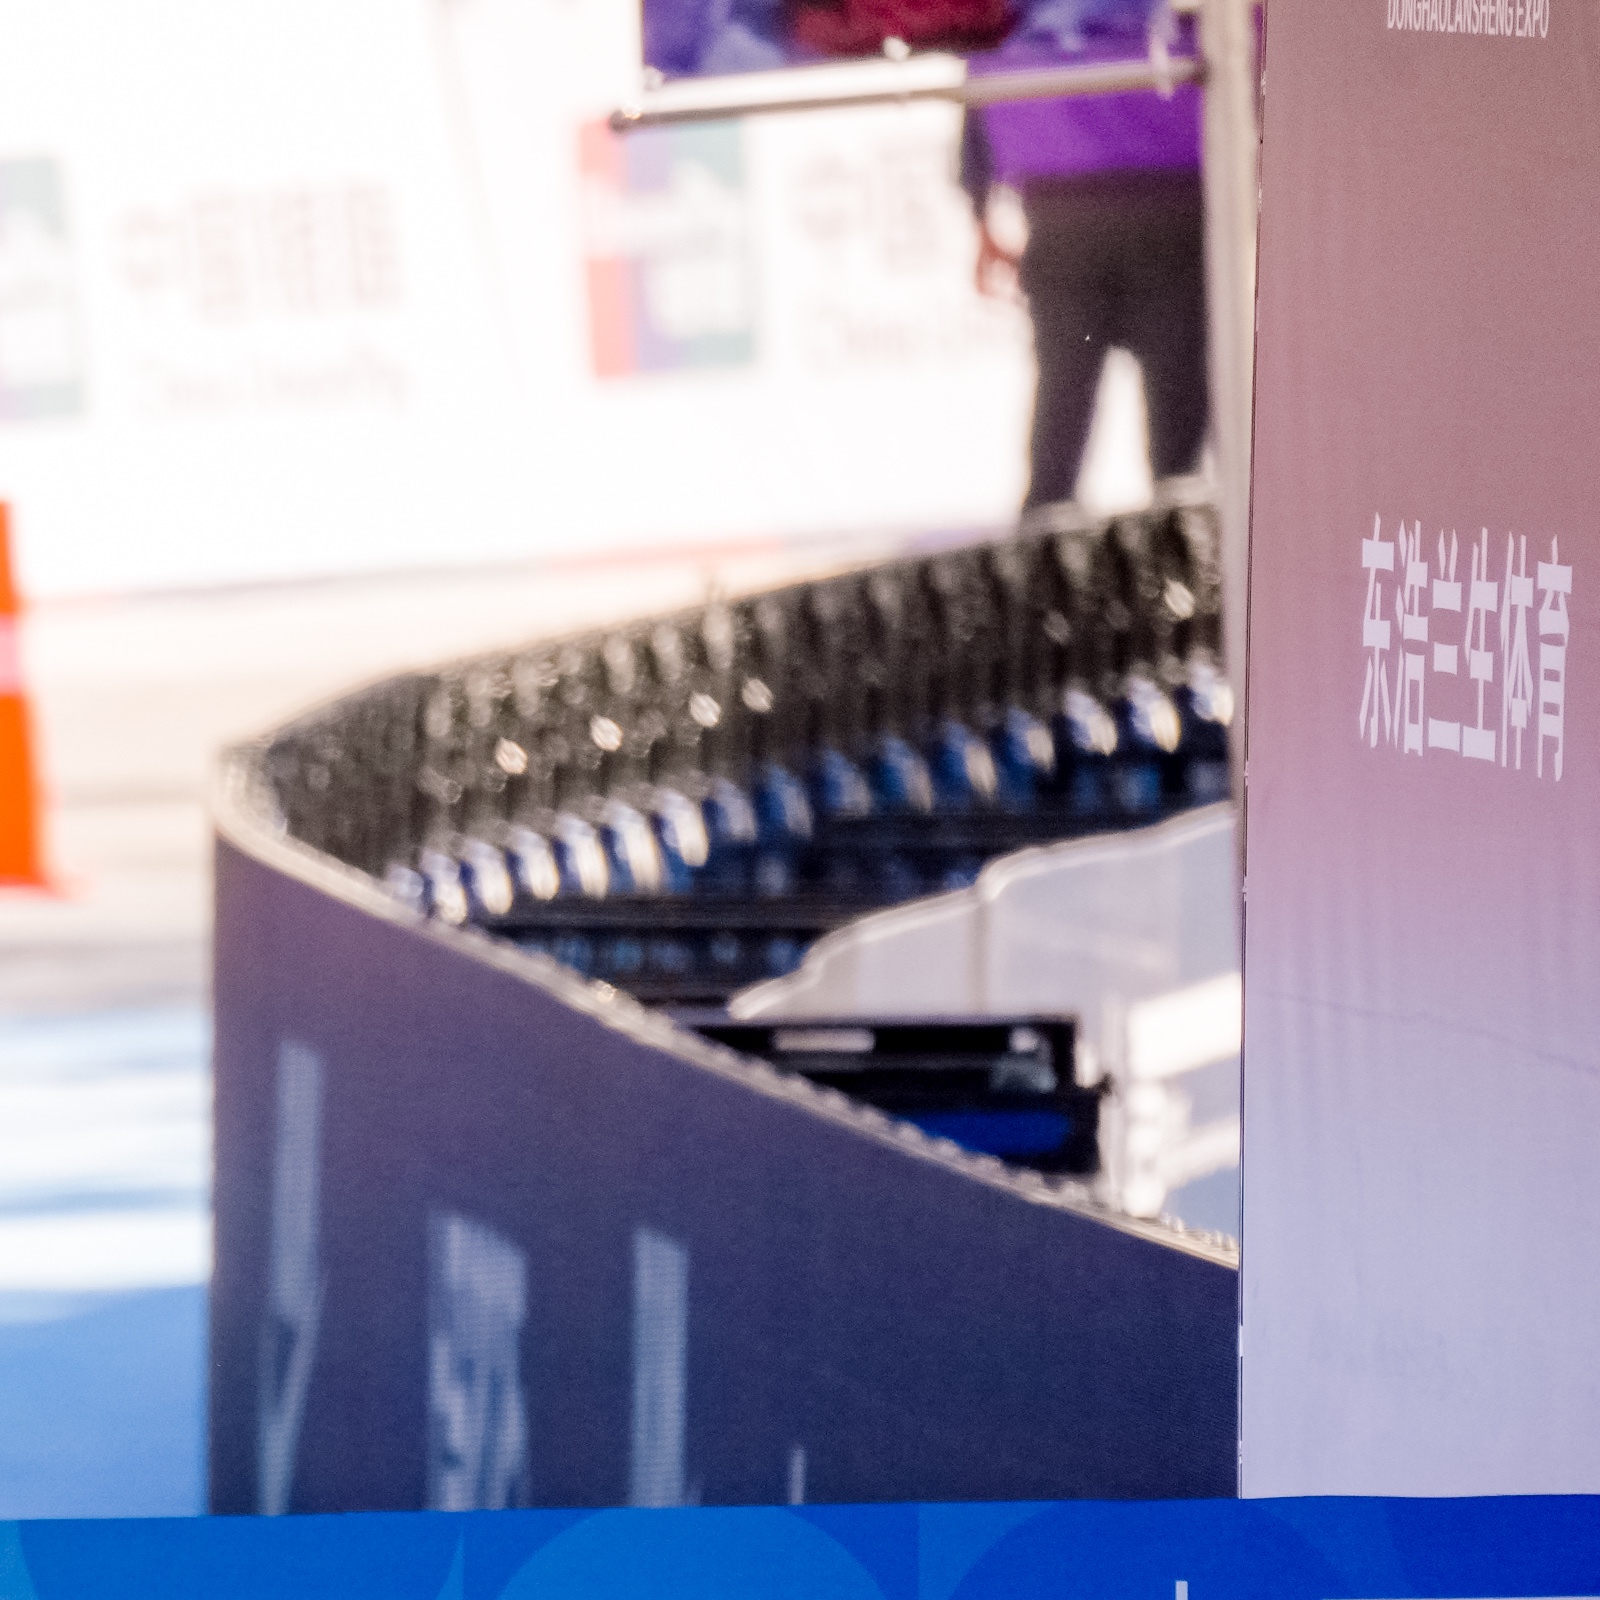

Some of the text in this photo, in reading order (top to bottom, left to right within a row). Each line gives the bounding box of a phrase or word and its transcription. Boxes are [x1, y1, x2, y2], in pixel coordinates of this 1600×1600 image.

[1515, 0, 1550, 39] EXPO
[1358, 511, 1573, 782] 东浩兰生体育
